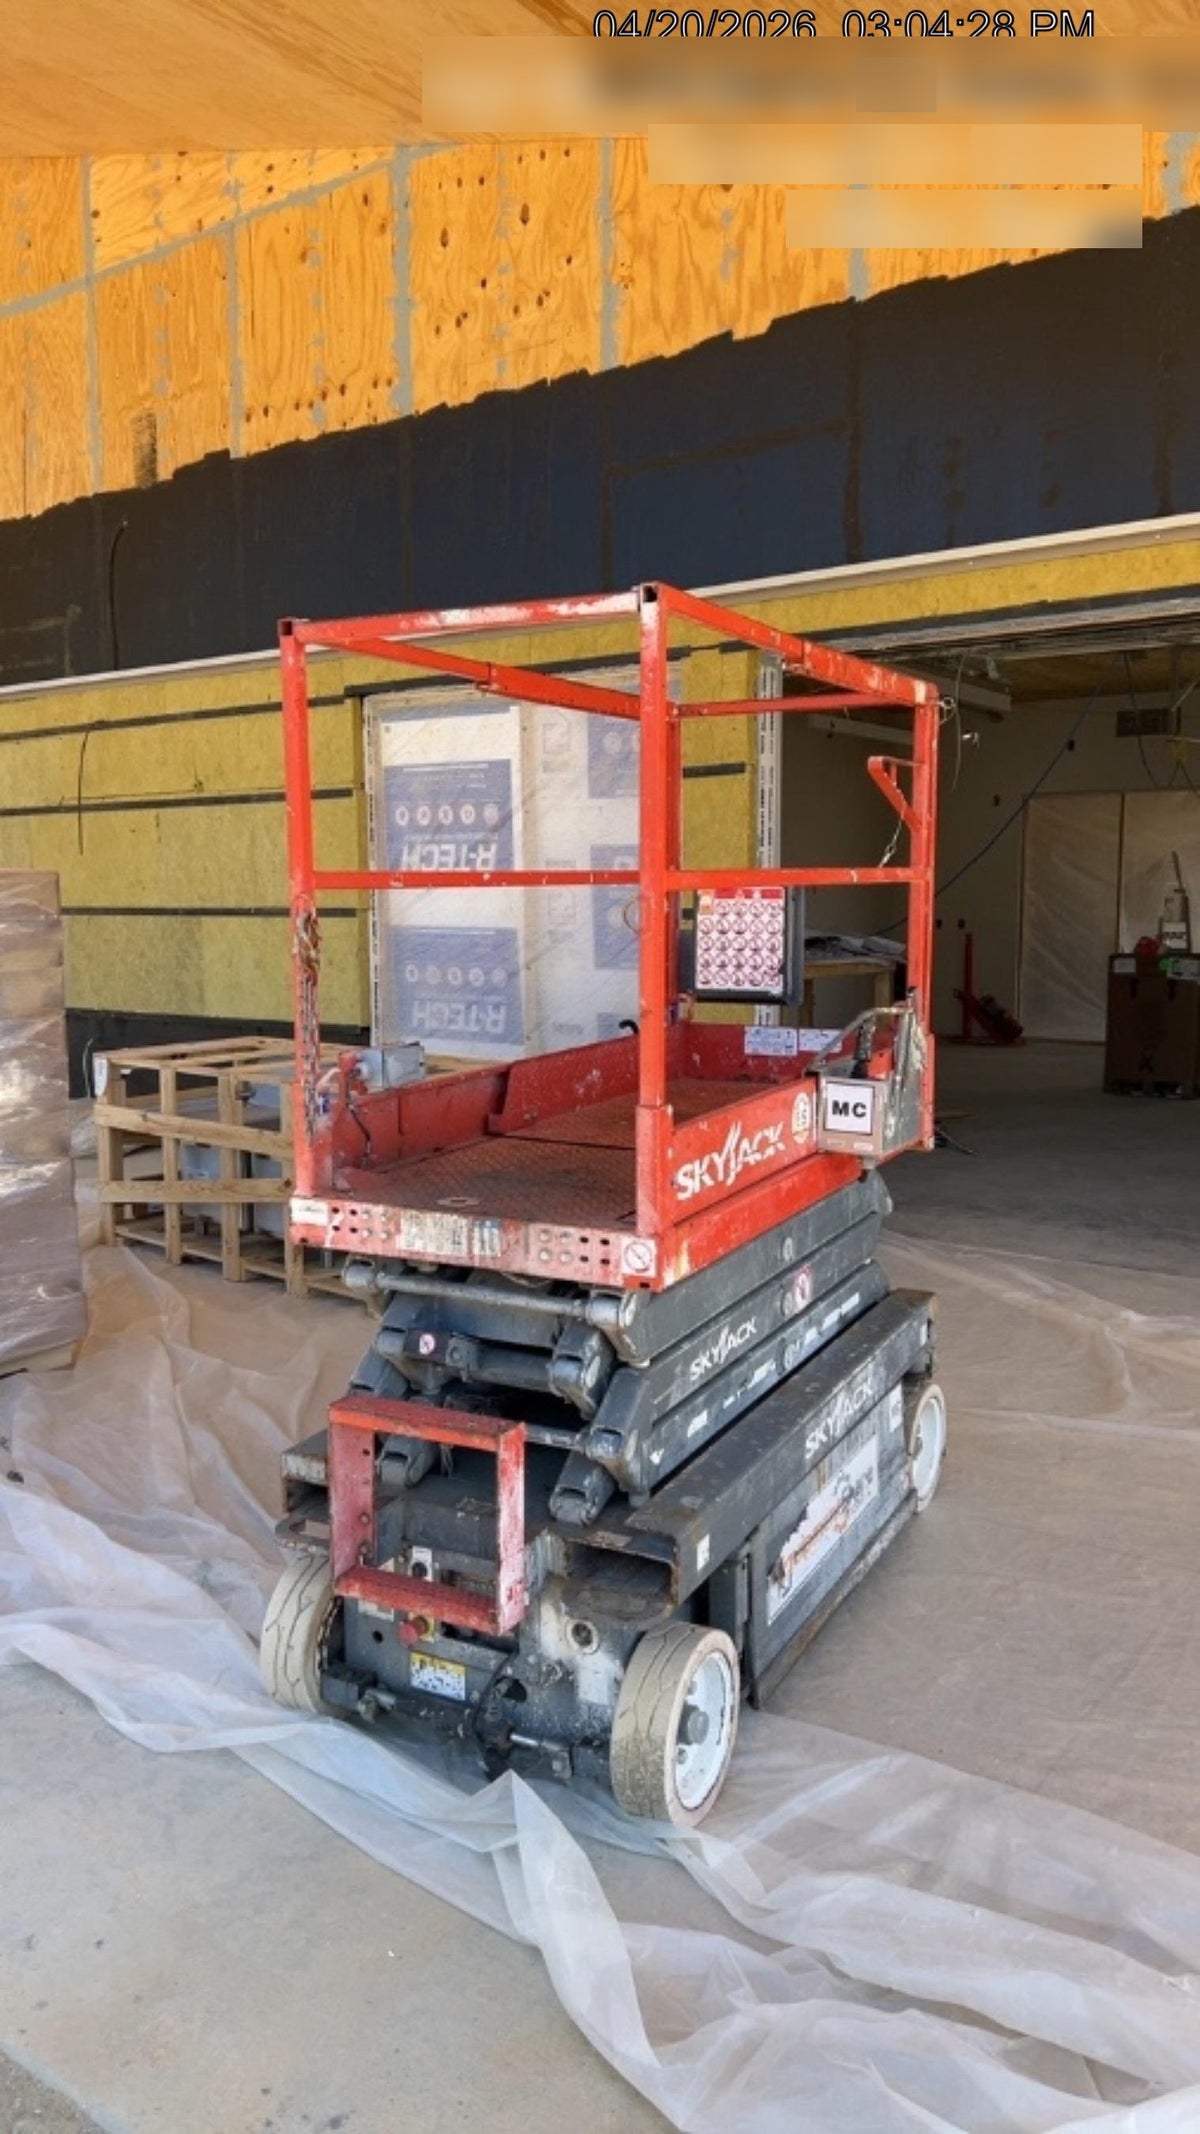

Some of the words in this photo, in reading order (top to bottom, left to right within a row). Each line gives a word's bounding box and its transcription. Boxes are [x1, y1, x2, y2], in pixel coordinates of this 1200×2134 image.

[402, 842, 497, 872] R-TECH
[412, 1000, 507, 1034] R-TECH
[832, 1099, 867, 1118] MC
[675, 1121, 786, 1200] SKYJACK
[689, 1317, 758, 1382] SKYJACK
